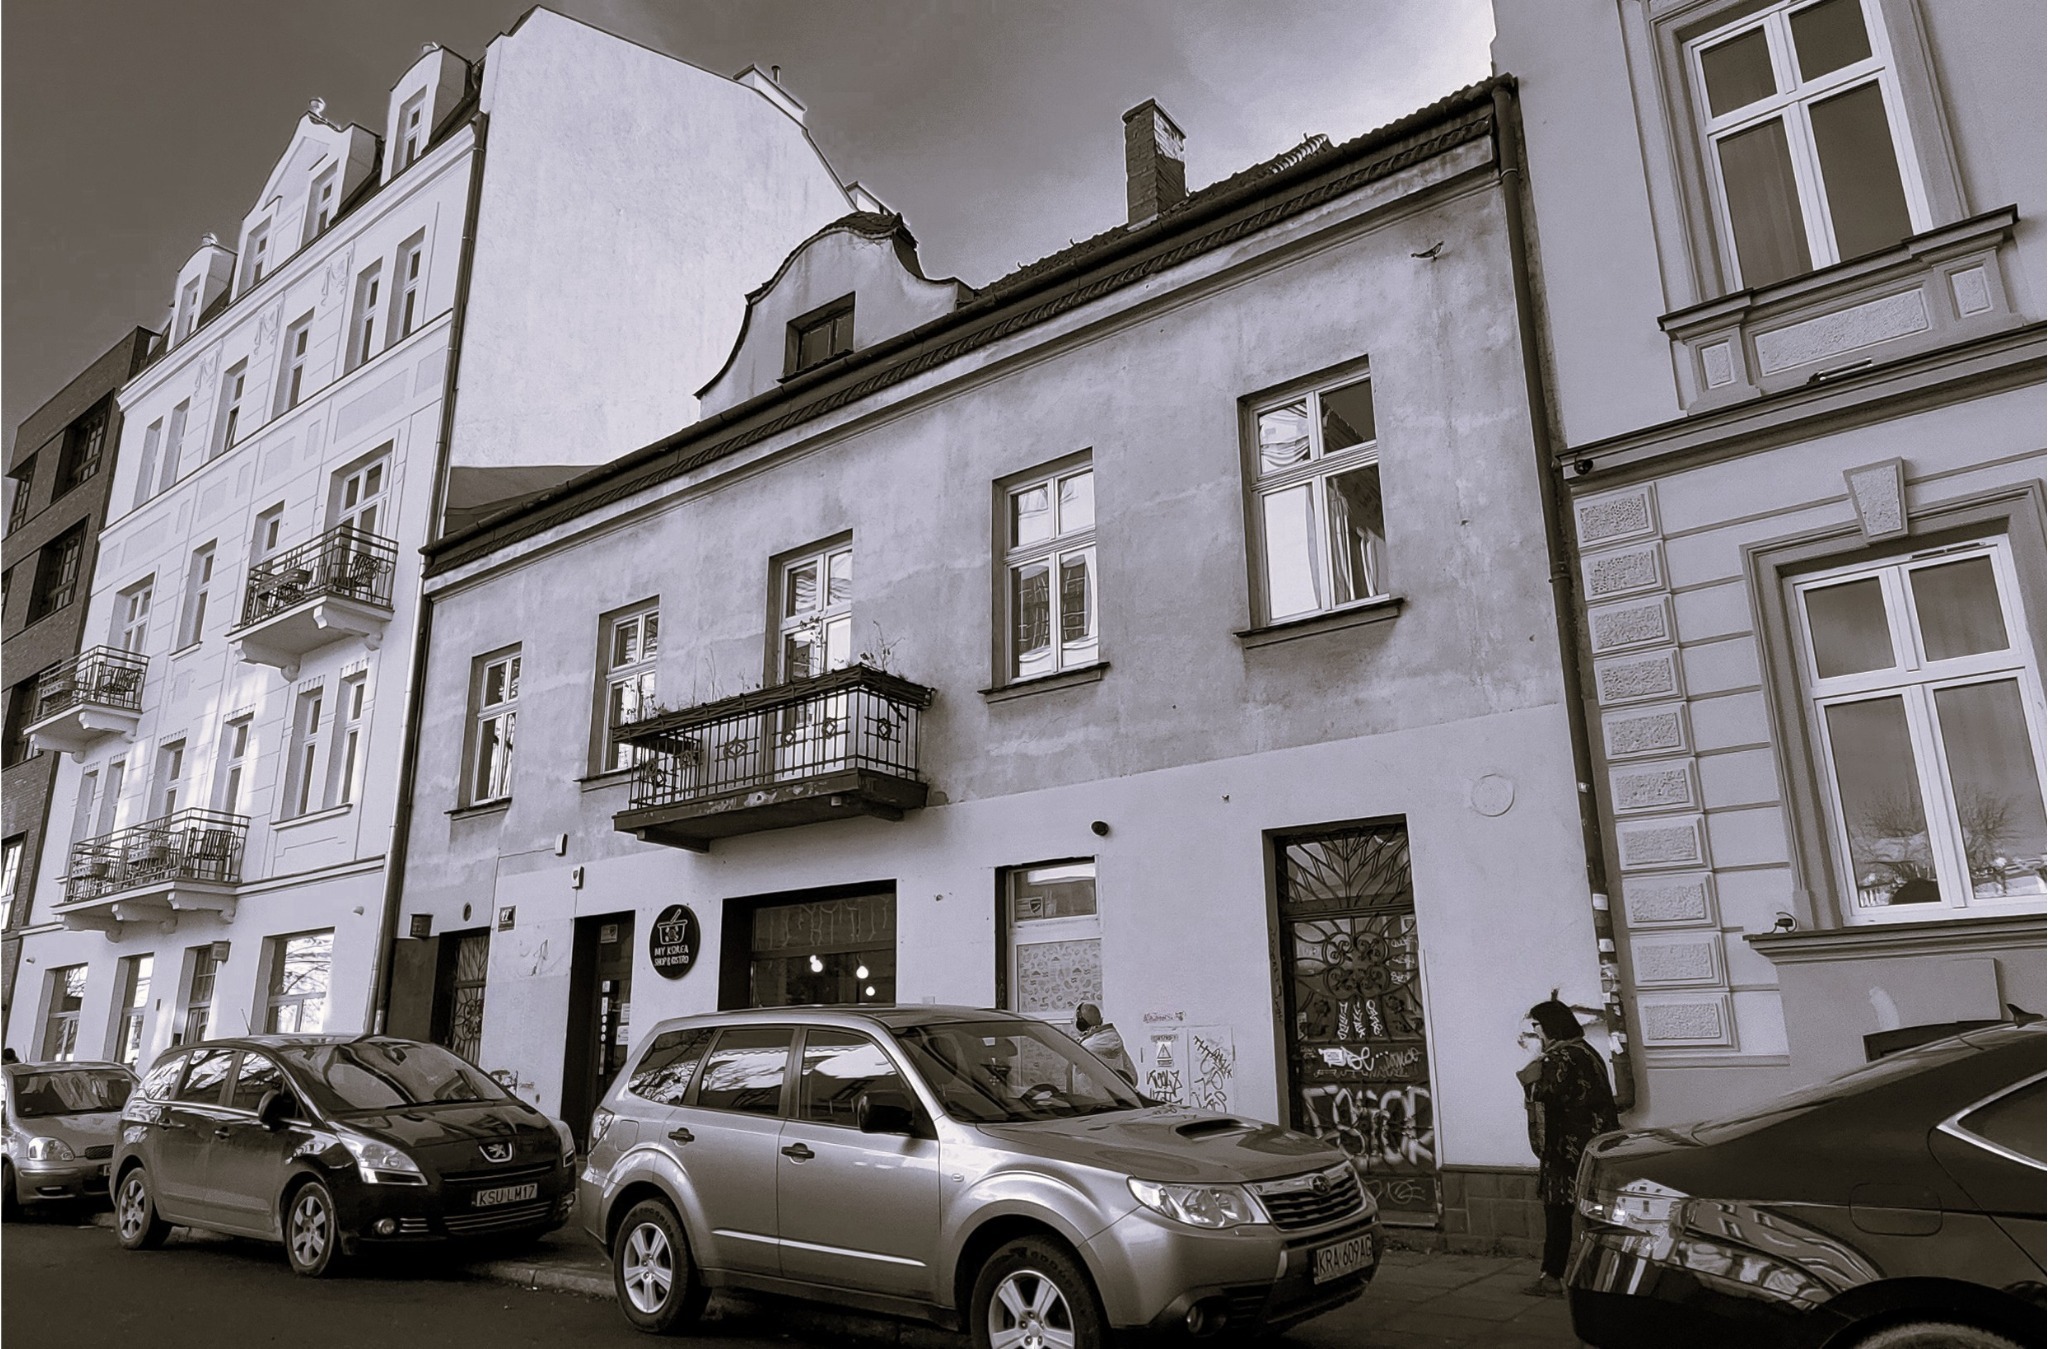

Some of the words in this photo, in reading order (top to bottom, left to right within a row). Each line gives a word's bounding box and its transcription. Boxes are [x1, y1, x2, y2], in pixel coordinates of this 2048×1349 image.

[654, 946, 666, 956] MY
[666, 944, 689, 956] KOREA
[480, 1189, 504, 1205] KSU
[507, 1184, 535, 1202] LM17
[1319, 1246, 1341, 1275] KRA
[1342, 1236, 1372, 1267] 609AG
